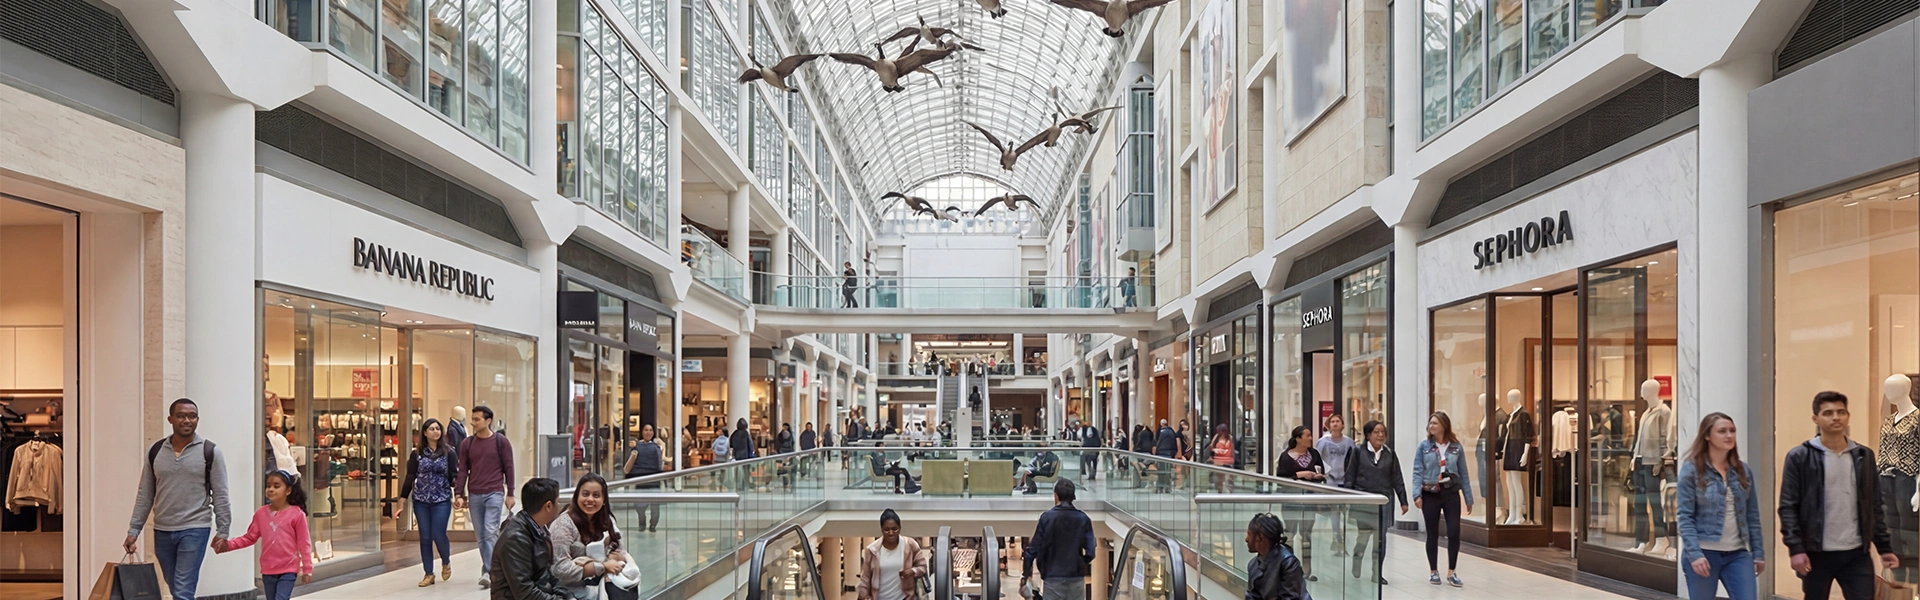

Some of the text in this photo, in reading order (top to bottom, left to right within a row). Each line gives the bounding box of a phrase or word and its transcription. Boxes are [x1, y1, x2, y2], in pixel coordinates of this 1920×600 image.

[353, 237, 495, 301] BANANA REPUBLIC
[1473, 210, 1574, 270] SEPHORA
[1302, 305, 1333, 328] SEPHORA
